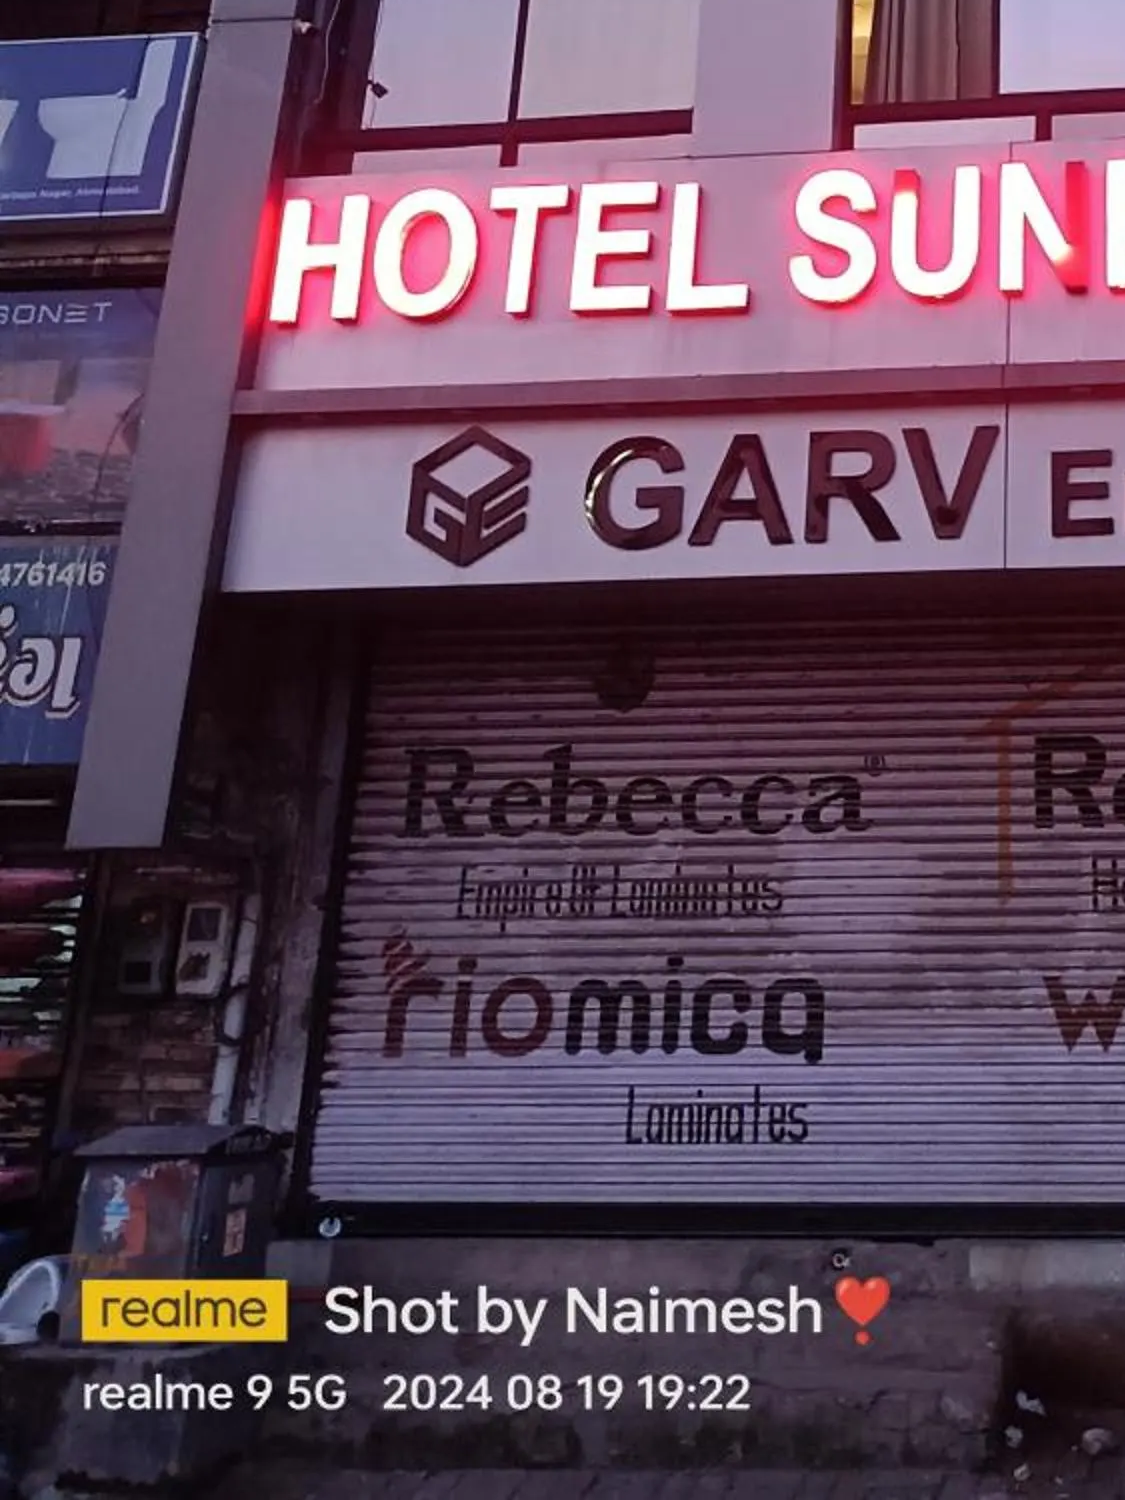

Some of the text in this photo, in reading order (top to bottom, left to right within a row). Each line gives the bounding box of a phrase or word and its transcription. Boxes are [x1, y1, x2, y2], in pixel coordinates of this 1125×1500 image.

[267, 180, 751, 325] HOTEL
[584, 422, 1001, 552] GARV
[399, 744, 872, 838] Rebecca
[624, 1084, 809, 1146] Laminates
